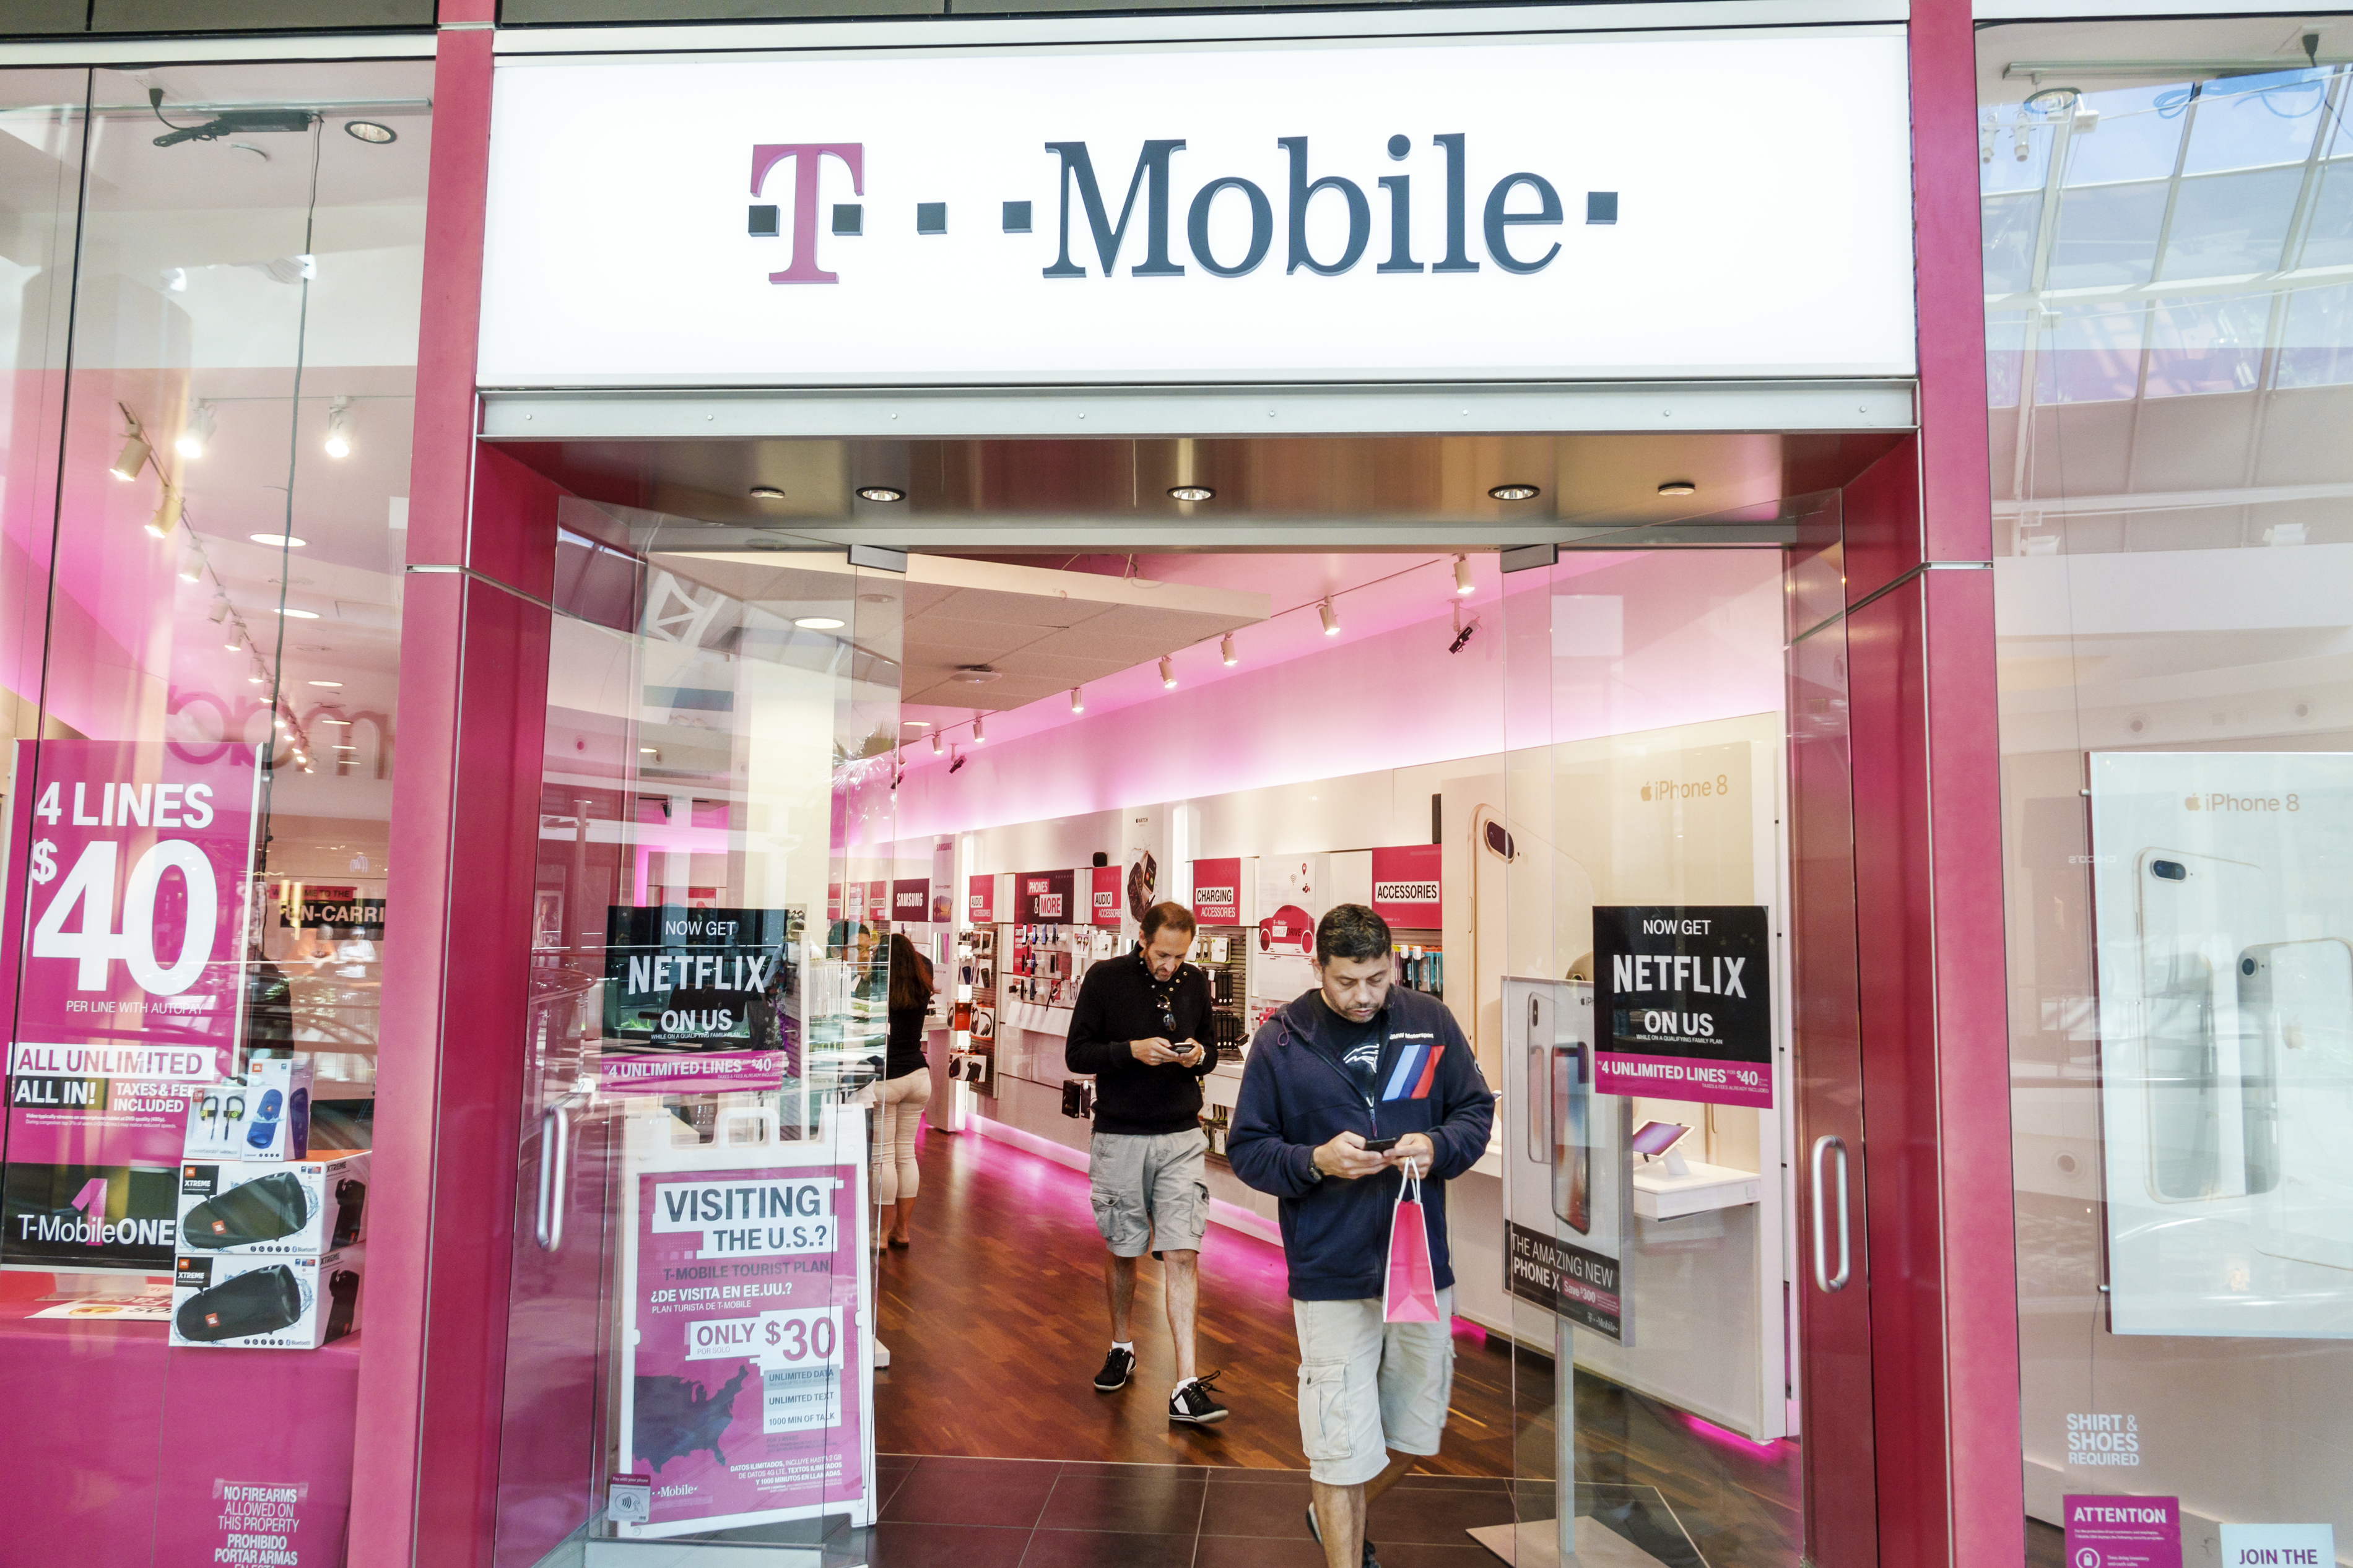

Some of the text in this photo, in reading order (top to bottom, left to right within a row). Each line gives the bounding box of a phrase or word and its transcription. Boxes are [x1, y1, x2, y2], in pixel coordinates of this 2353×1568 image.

[1655, 774, 1728, 801] iPhone 8
[37, 781, 214, 829] 4 LINES
[2206, 793, 2300, 812] iPhone 8
[936, 842, 952, 852] SAMSUNG
[1029, 881, 1048, 893] PHONES
[1197, 889, 1232, 902] CHARGING
[1377, 884, 1437, 899] ACCESSORIES
[897, 892, 923, 907] SAMSUNG
[971, 897, 982, 906] AUDIO
[1034, 897, 1061, 914] & MORE
[1095, 893, 1111, 905] AUDIO
[32, 838, 218, 996] $40
[285, 906, 385, 922] UN-CARRI
[973, 909, 991, 917] ACCESSORIES
[1098, 908, 1121, 918] ACCESSORIE
[1201, 907, 1235, 917] ACCESSORIES
[665, 920, 736, 936] NOW GET
[1286, 928, 1302, 937] DRIVE
[1643, 919, 1711, 935] NOW GET
[628, 955, 767, 995] NETFLIX
[1613, 954, 1747, 998] NETFLIX
[66, 1000, 204, 1015] PER LINE WITH AUTOPAY
[661, 1008, 733, 1032] ON US
[1644, 1010, 1715, 1037] ON US
[18, 1048, 202, 1075] ALL UNLIMITED
[621, 1058, 772, 1077] UNLIMITED LINES $40
[1601, 1060, 1609, 1074] 4
[1611, 1061, 1684, 1079] UNLIMITED
[1686, 1067, 1726, 1083] LINES
[1736, 1070, 1758, 1086] $40
[14, 1079, 97, 1105] ALL IN!
[115, 1082, 196, 1098] TAXES & FEE
[113, 1098, 184, 1112] INCLUDED
[327, 1161, 347, 1172] XTREME
[664, 1185, 821, 1223] VISITING
[713, 1225, 827, 1252] THE U.S.?
[321, 1252, 341, 1265] XTREME
[1511, 1232, 1613, 1288] THE AMAZING NEW
[178, 1271, 204, 1280] XTREME
[664, 1260, 830, 1281] T-MOBILE TOURIST PLAN
[1514, 1257, 1560, 1293] PHONE X
[650, 1282, 793, 1303] ¿DE VISITA EN EE.UU.?
[1564, 1280, 1596, 1303] Save $300
[651, 1300, 752, 1314] PLAN TURISTA DE T-MOBILE
[697, 1317, 837, 1362] ONLY $30
[697, 1346, 731, 1354] POR SOLO
[769, 1369, 834, 1382] UNLIMITED DATA
[769, 1392, 834, 1405] UNLIMITED TEXT
[769, 1417, 786, 1426] 1000
[788, 1415, 802, 1424] MIN
[804, 1414, 814, 1423] OF
[2066, 1413, 2138, 1432] SHIRT &
[2068, 1432, 2139, 1452] SHOES
[730, 1463, 750, 1472] DATOS
[750, 1460, 785, 1470] ILIMITADOS,
[785, 1458, 809, 1466] INCLUYE
[810, 1455, 828, 1463] HASTA
[2068, 1452, 2140, 1466] REQUIRED
[747, 1470, 766, 1478] DATOS
[788, 1465, 810, 1474] TEXTOS
[775, 1475, 801, 1483] MINUTOS
[224, 1486, 297, 1503] NO FIREARMS
[224, 1501, 294, 1518] ALLOWED ON
[2074, 1507, 2167, 1523] ATTENTION
[218, 1515, 300, 1533] THIS PROPERTY
[227, 1533, 287, 1550] PROHIBIDO
[214, 1548, 298, 1566] PORTAR ARMAS
[2239, 1549, 2318, 1566] JOIN THE
